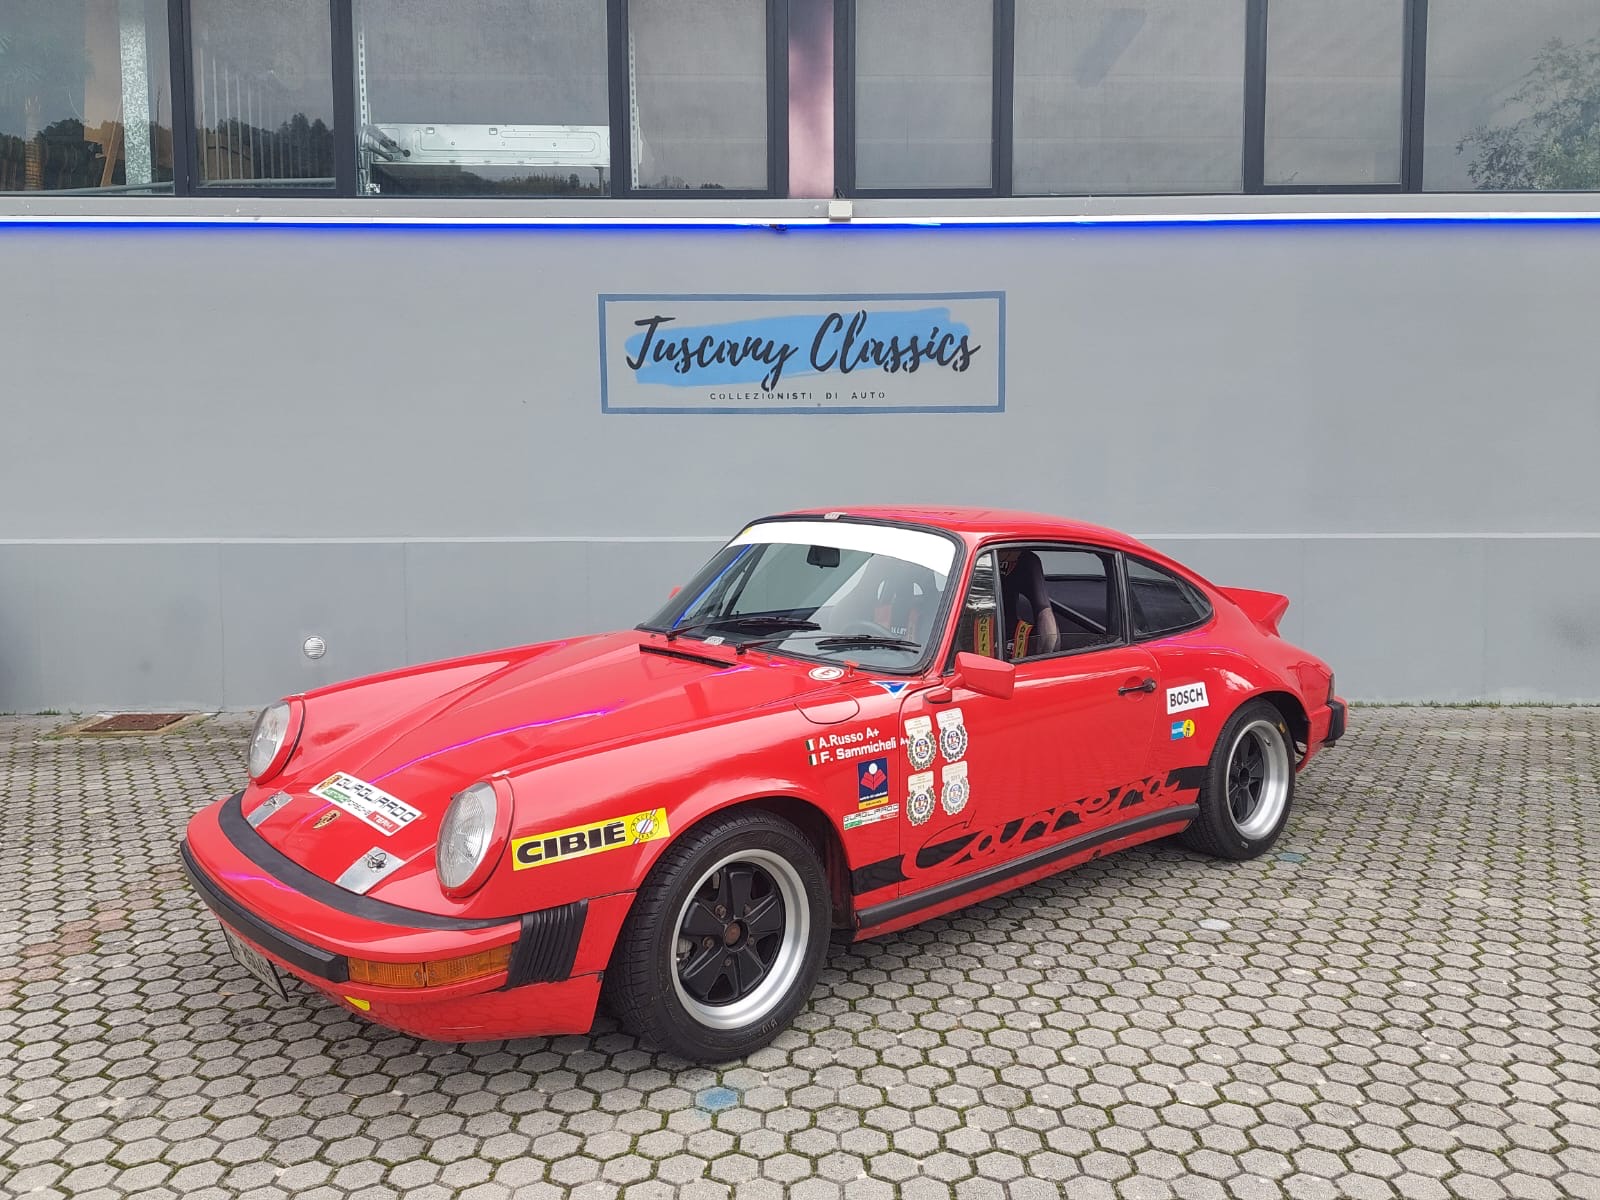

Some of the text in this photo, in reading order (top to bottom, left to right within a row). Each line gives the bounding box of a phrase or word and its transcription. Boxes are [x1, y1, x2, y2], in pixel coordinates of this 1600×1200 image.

[626, 309, 981, 391] Tuscany Classics
[709, 391, 885, 400] COLLEZIONISTI DI AUTO
[1170, 687, 1204, 707] BOSCH
[819, 727, 880, 749] A.Russo A+
[820, 750, 834, 763] F.
[836, 737, 897, 759] Sammicheli
[901, 770, 1181, 880] Carrera
